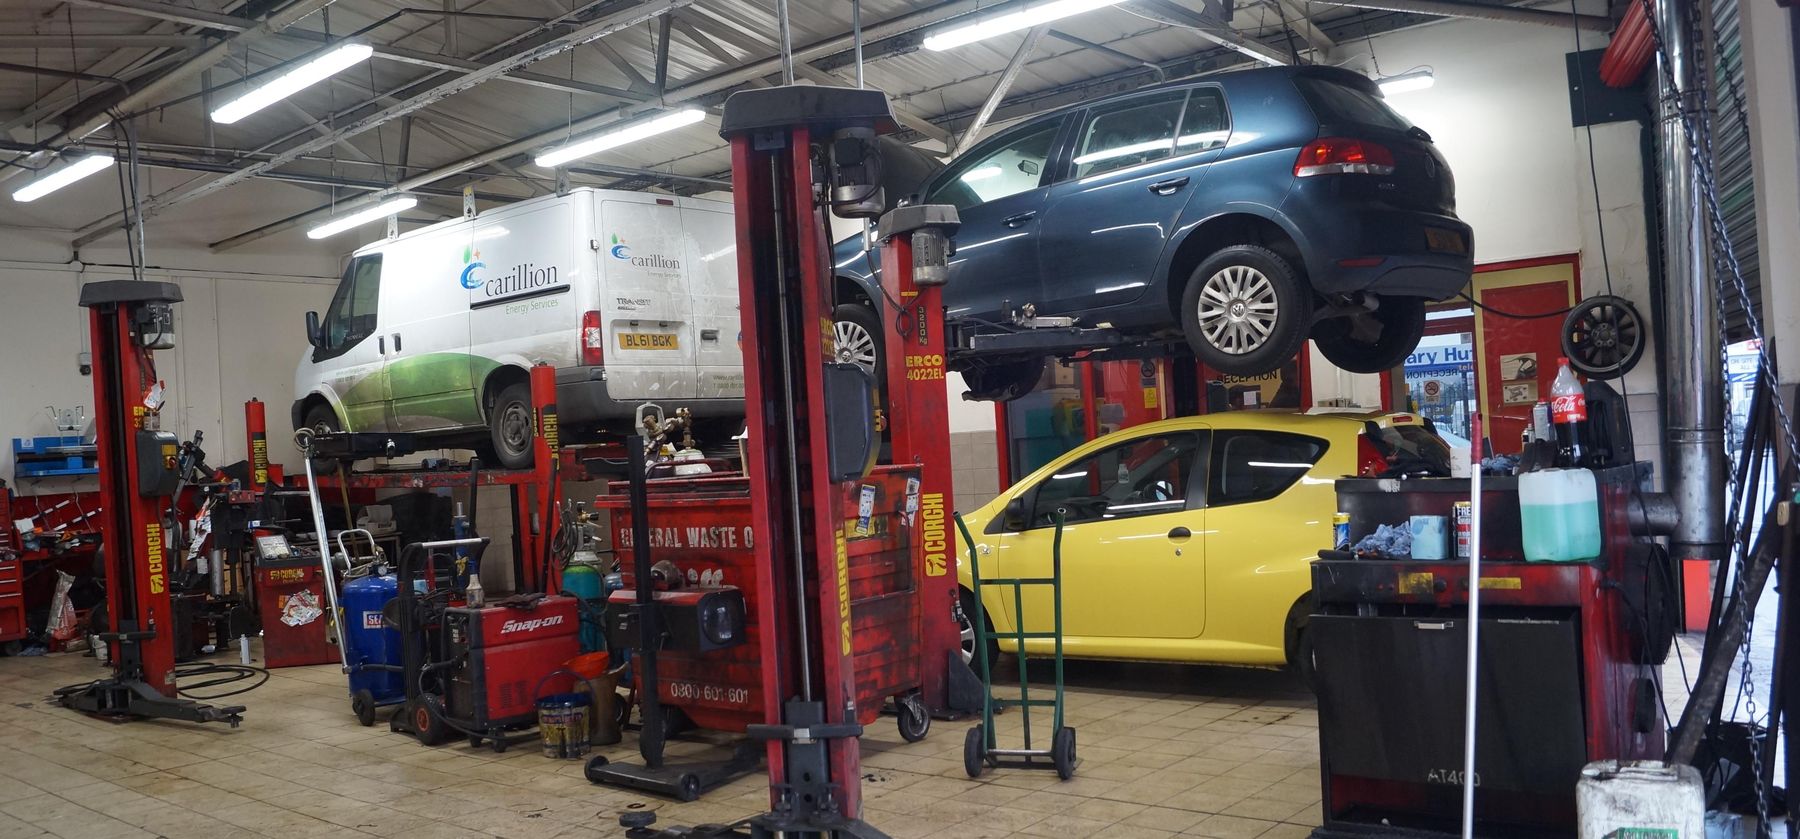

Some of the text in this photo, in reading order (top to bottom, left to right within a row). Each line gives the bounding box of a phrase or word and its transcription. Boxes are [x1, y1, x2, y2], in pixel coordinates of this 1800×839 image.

[631, 254, 681, 270] carillion
[485, 262, 560, 297] carillion
[505, 298, 559, 316] Energy Services
[626, 334, 673, 347] BL61 BGK
[905, 354, 943, 368] ERCO
[1404, 346, 1473, 366] ary Hu
[906, 367, 945, 381] 4022EL
[252, 439, 268, 469] CORGHI
[1457, 506, 1472, 517] FRE
[922, 492, 947, 552] CORGHI
[620, 526, 683, 548] GERAL
[686, 526, 737, 548] WASTE
[146, 523, 163, 574] CORGHI
[835, 529, 849, 619] CORGHI
[500, 615, 564, 634] Snap-on
